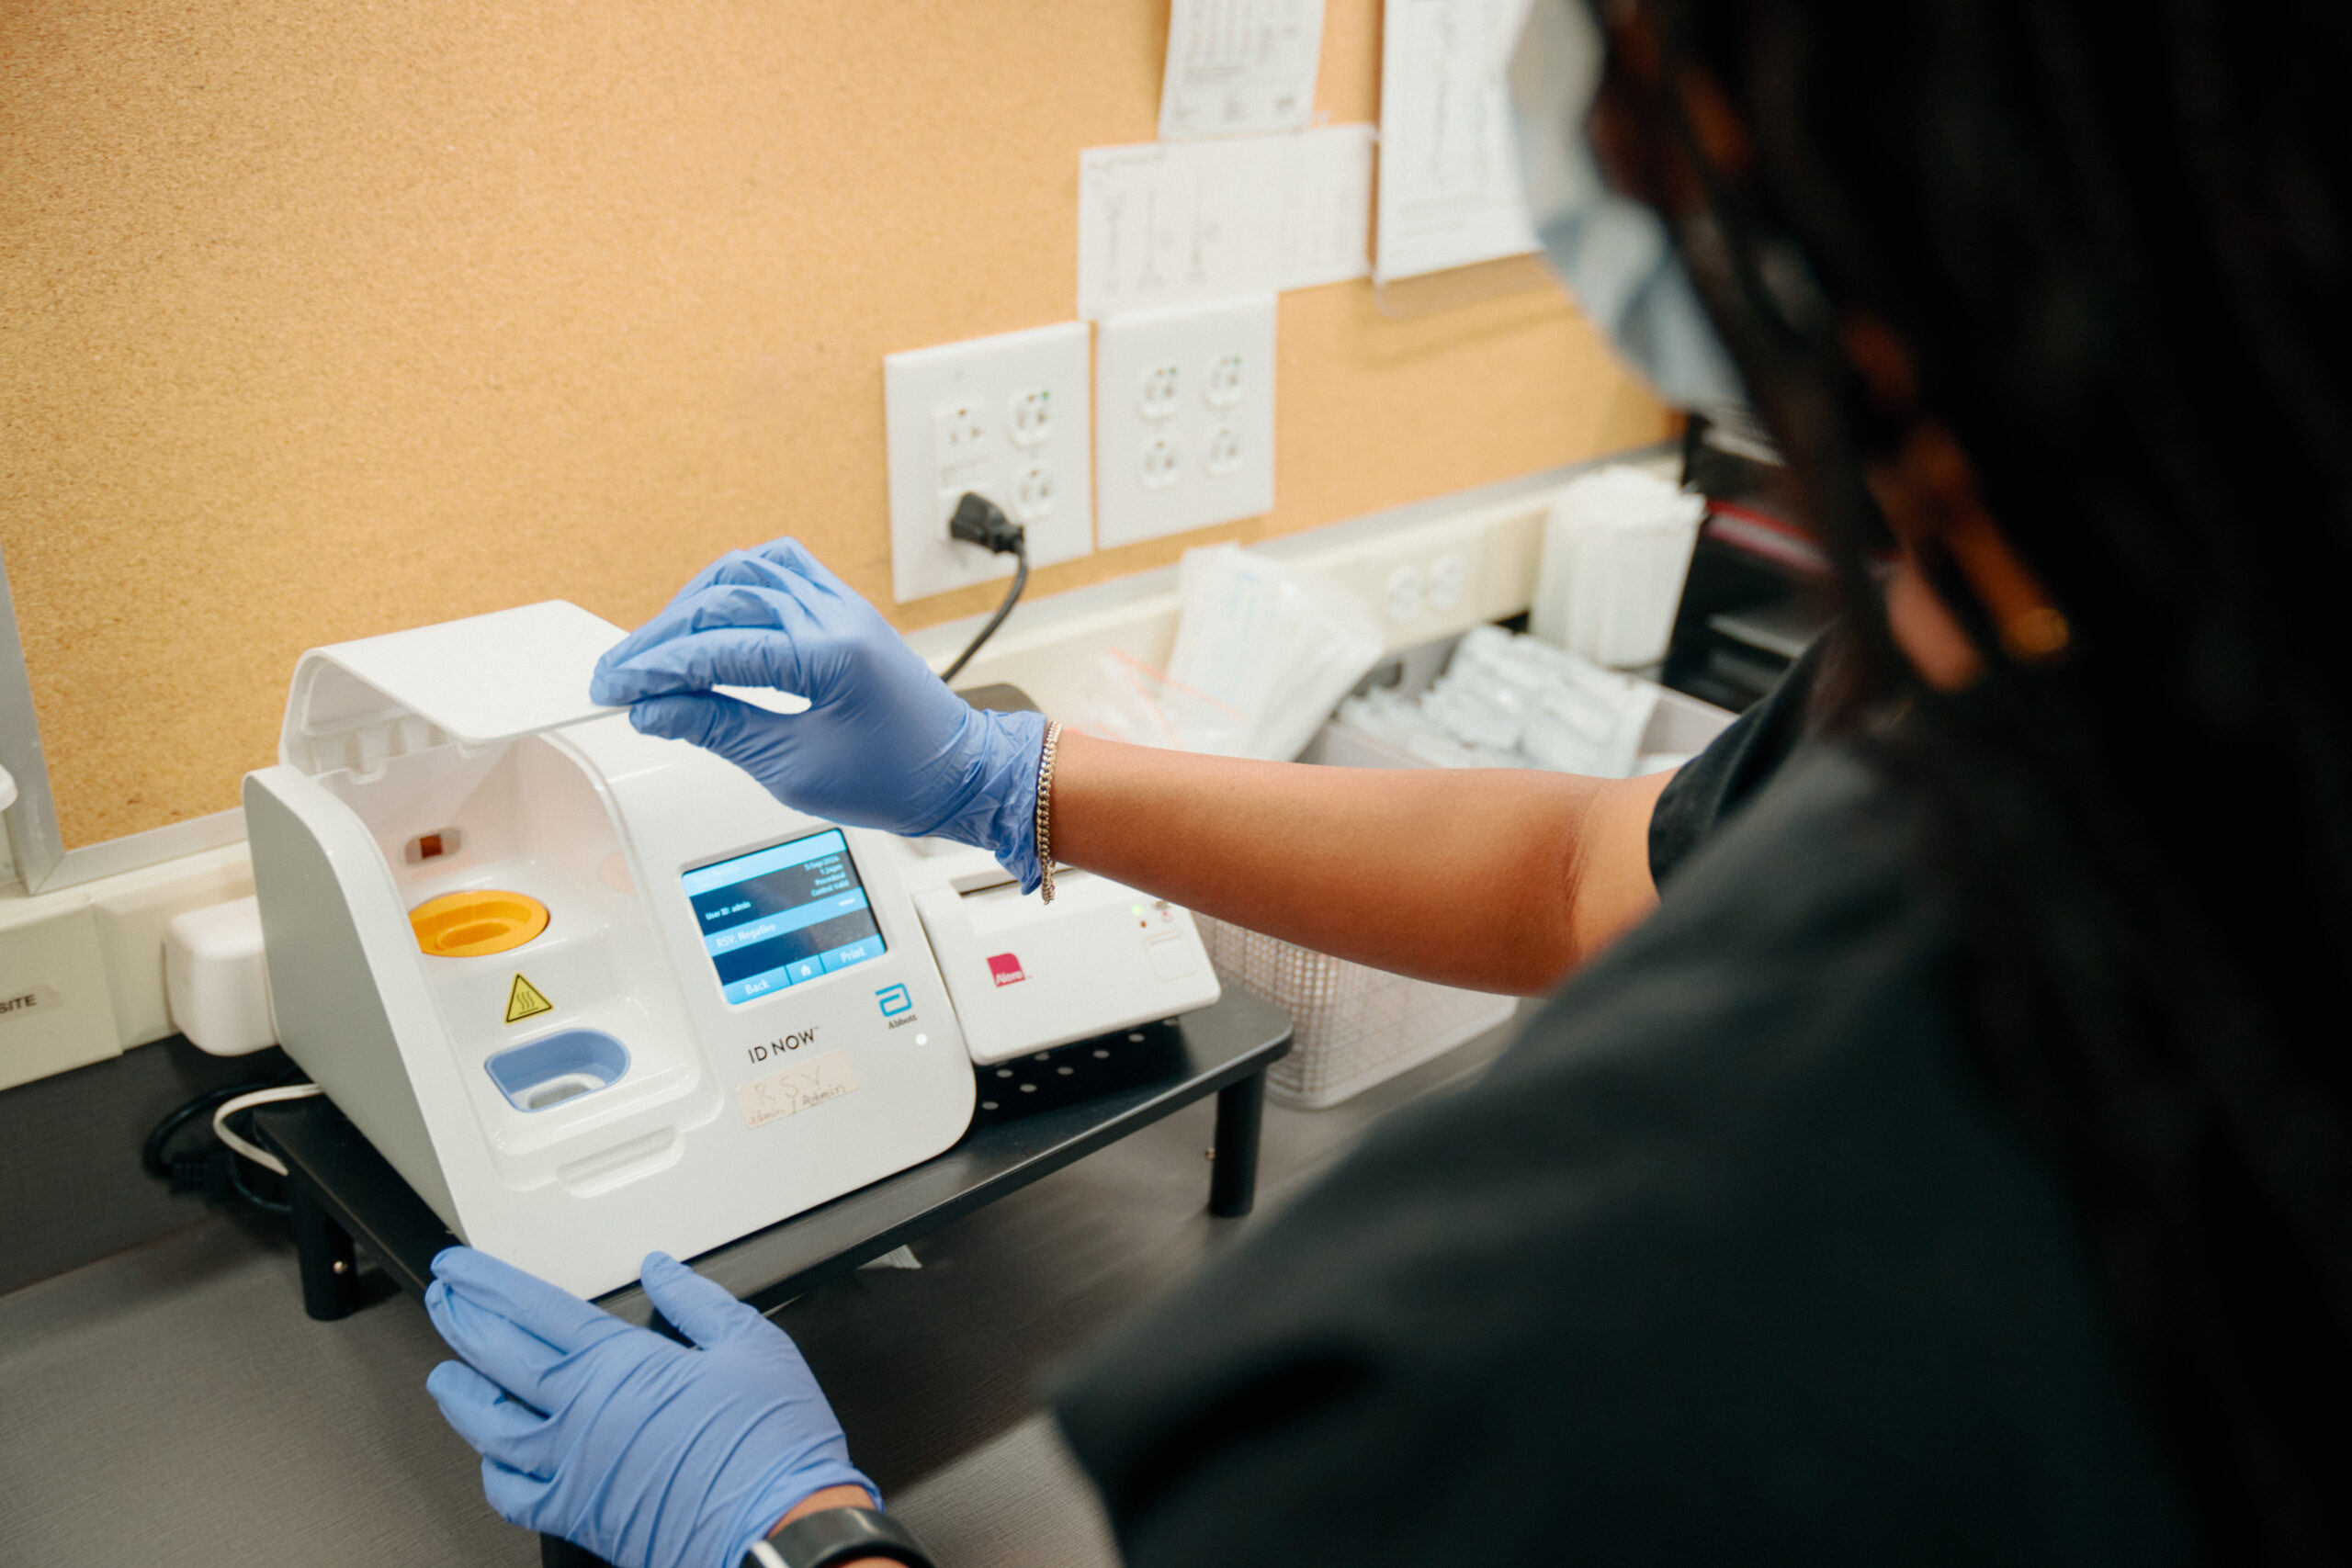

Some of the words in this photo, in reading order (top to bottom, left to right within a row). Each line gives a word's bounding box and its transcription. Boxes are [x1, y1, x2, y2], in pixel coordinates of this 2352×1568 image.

[705, 910, 721, 920] User
[731, 900, 752, 913] admin
[737, 922, 776, 942] Negative
[841, 947, 866, 963] Print
[744, 978, 770, 996] Back
[888, 1013, 918, 1030] Abbott
[748, 1045, 768, 1064] ID
